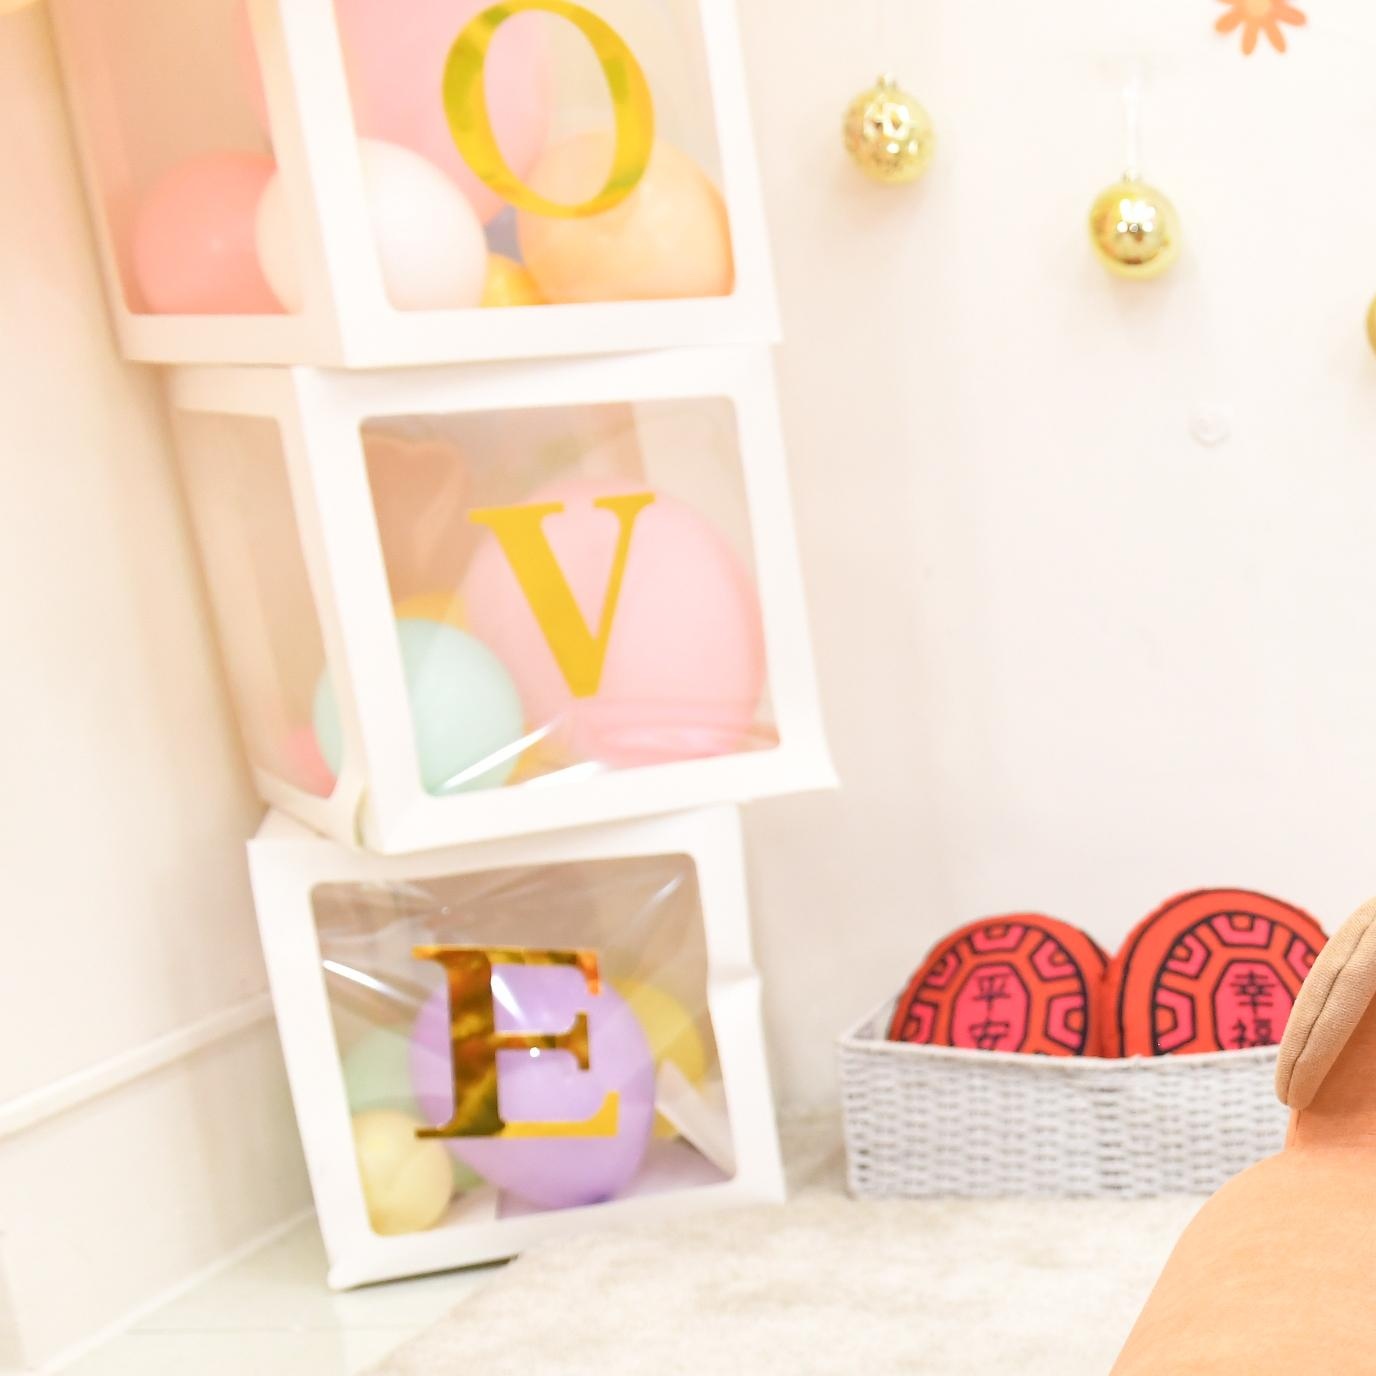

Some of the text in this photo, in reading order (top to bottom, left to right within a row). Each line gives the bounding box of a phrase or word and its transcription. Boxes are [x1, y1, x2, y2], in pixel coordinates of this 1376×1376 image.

[442, 0, 655, 219] O
[468, 492, 655, 697] V
[412, 944, 620, 1139] E
